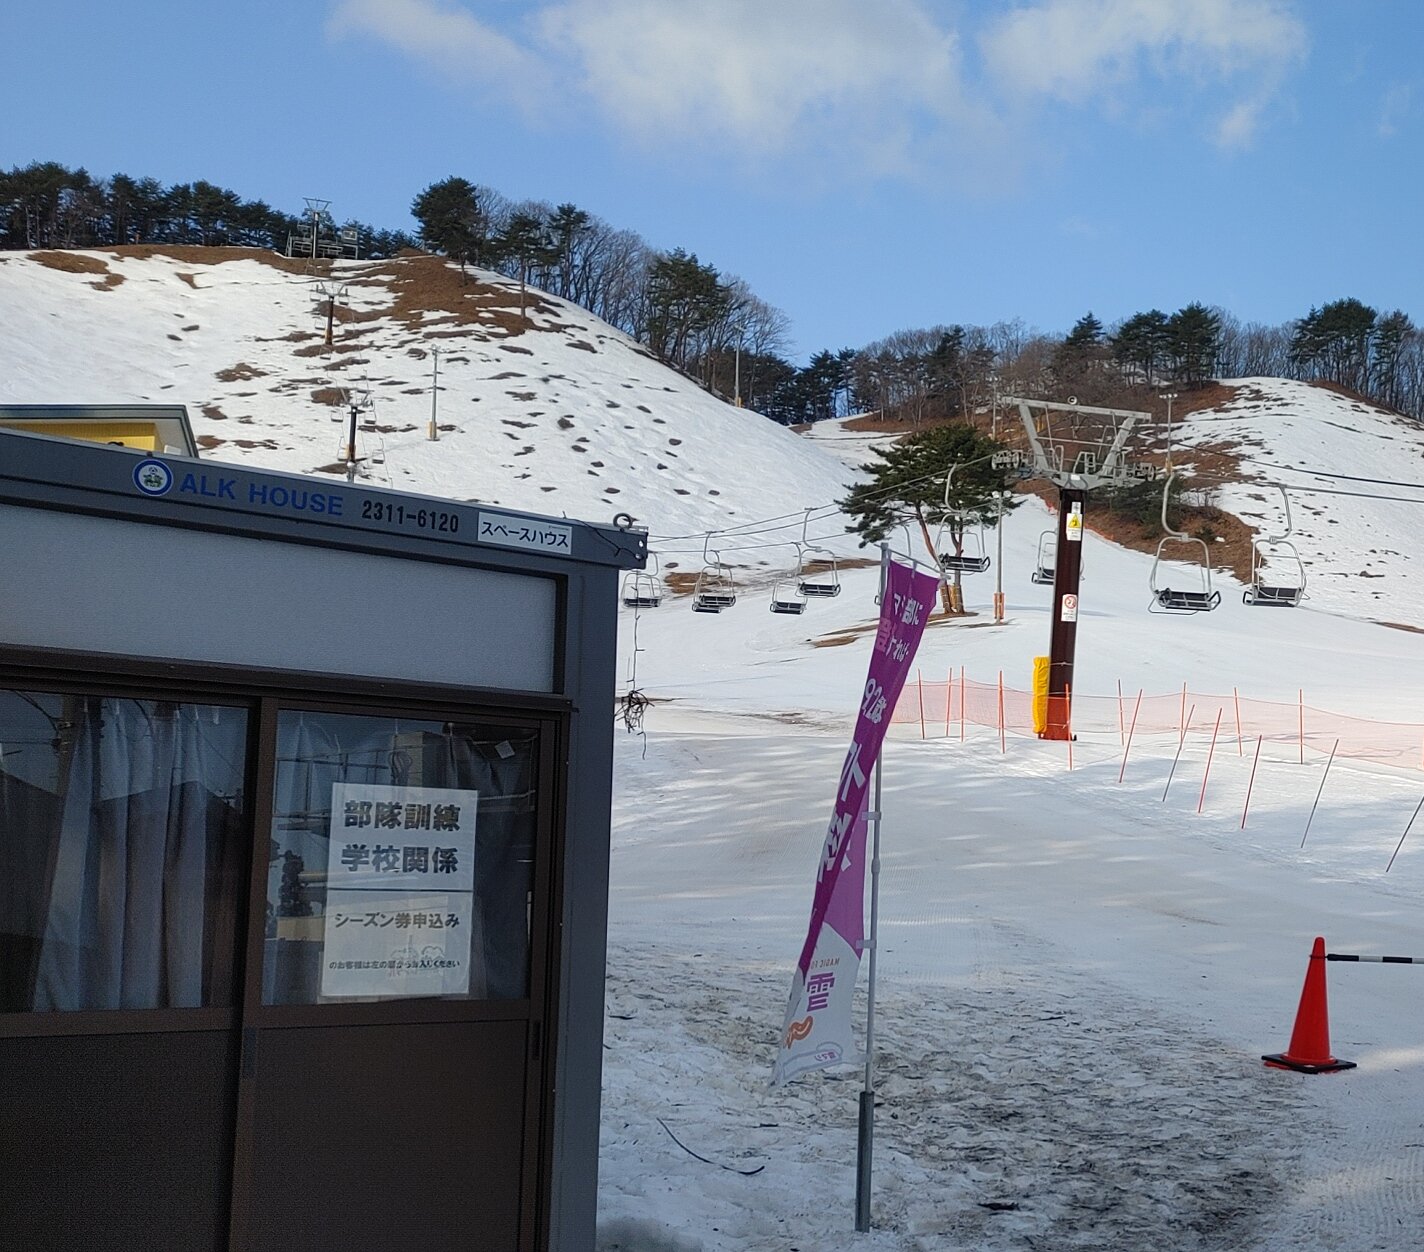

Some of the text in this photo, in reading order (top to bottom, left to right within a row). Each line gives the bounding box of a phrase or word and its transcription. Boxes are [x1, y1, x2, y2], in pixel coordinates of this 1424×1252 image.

[179, 473, 344, 516] ALK HOUSE
[361, 500, 459, 533] 2311-6120
[481, 521, 569, 548] スペースハウス
[343, 800, 461, 832] 部隊訓練
[341, 844, 459, 874] 学校関係
[334, 912, 460, 929] シーズン券申込み
